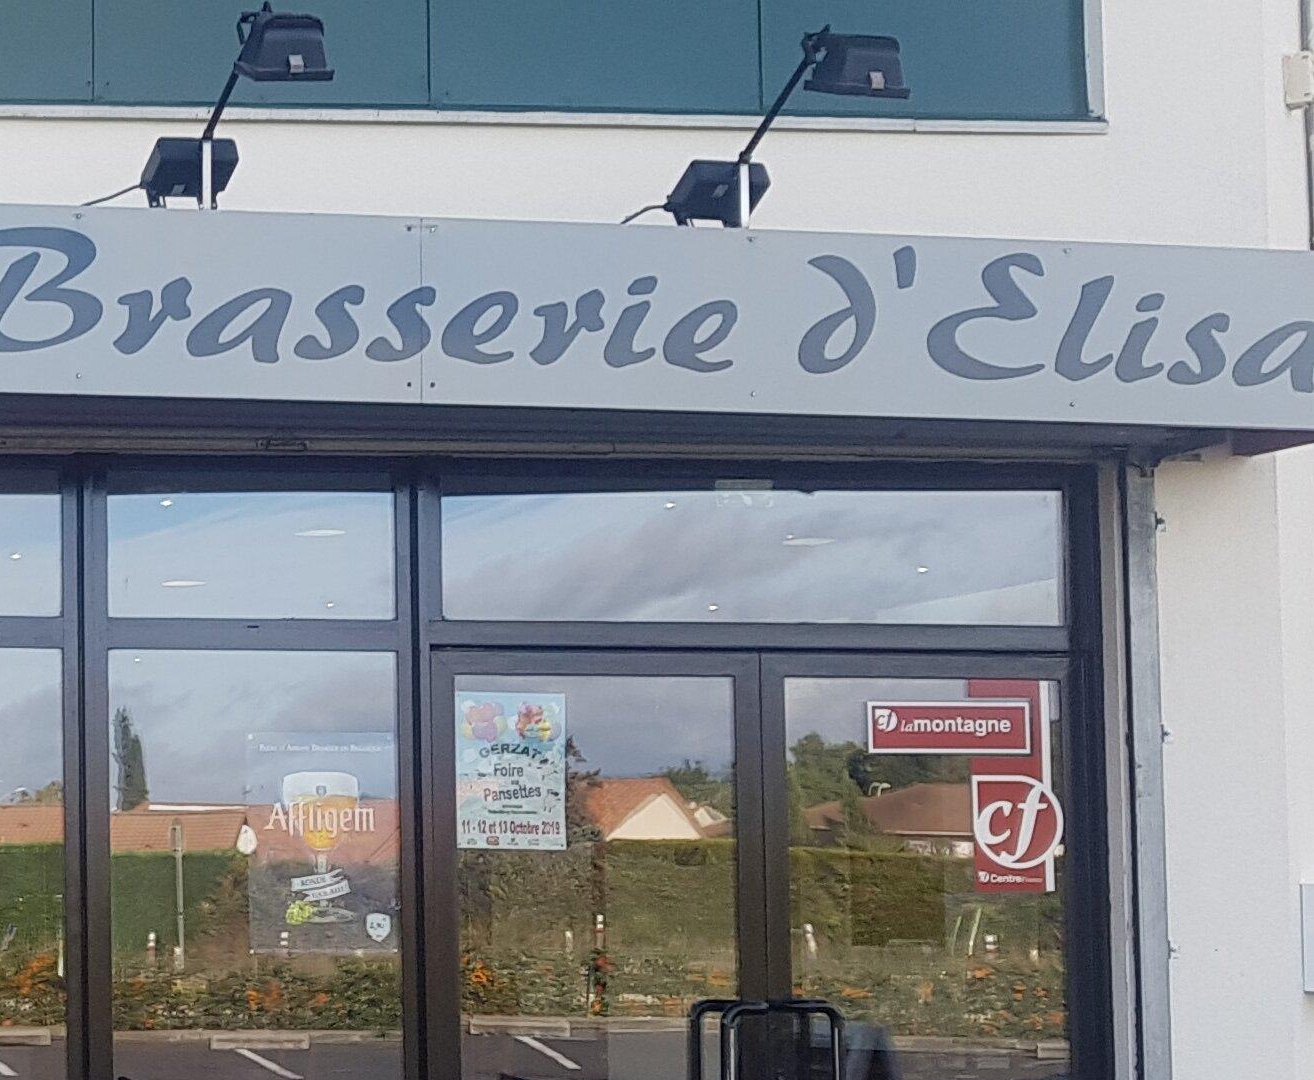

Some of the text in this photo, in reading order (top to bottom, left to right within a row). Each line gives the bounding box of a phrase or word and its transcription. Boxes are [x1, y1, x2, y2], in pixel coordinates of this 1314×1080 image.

[797, 245, 1314, 392] d'Elisa
[479, 744, 542, 758] GERZAT
[493, 762, 524, 777] Foire
[483, 784, 542, 801] Pansettes
[263, 800, 375, 838] Affligem
